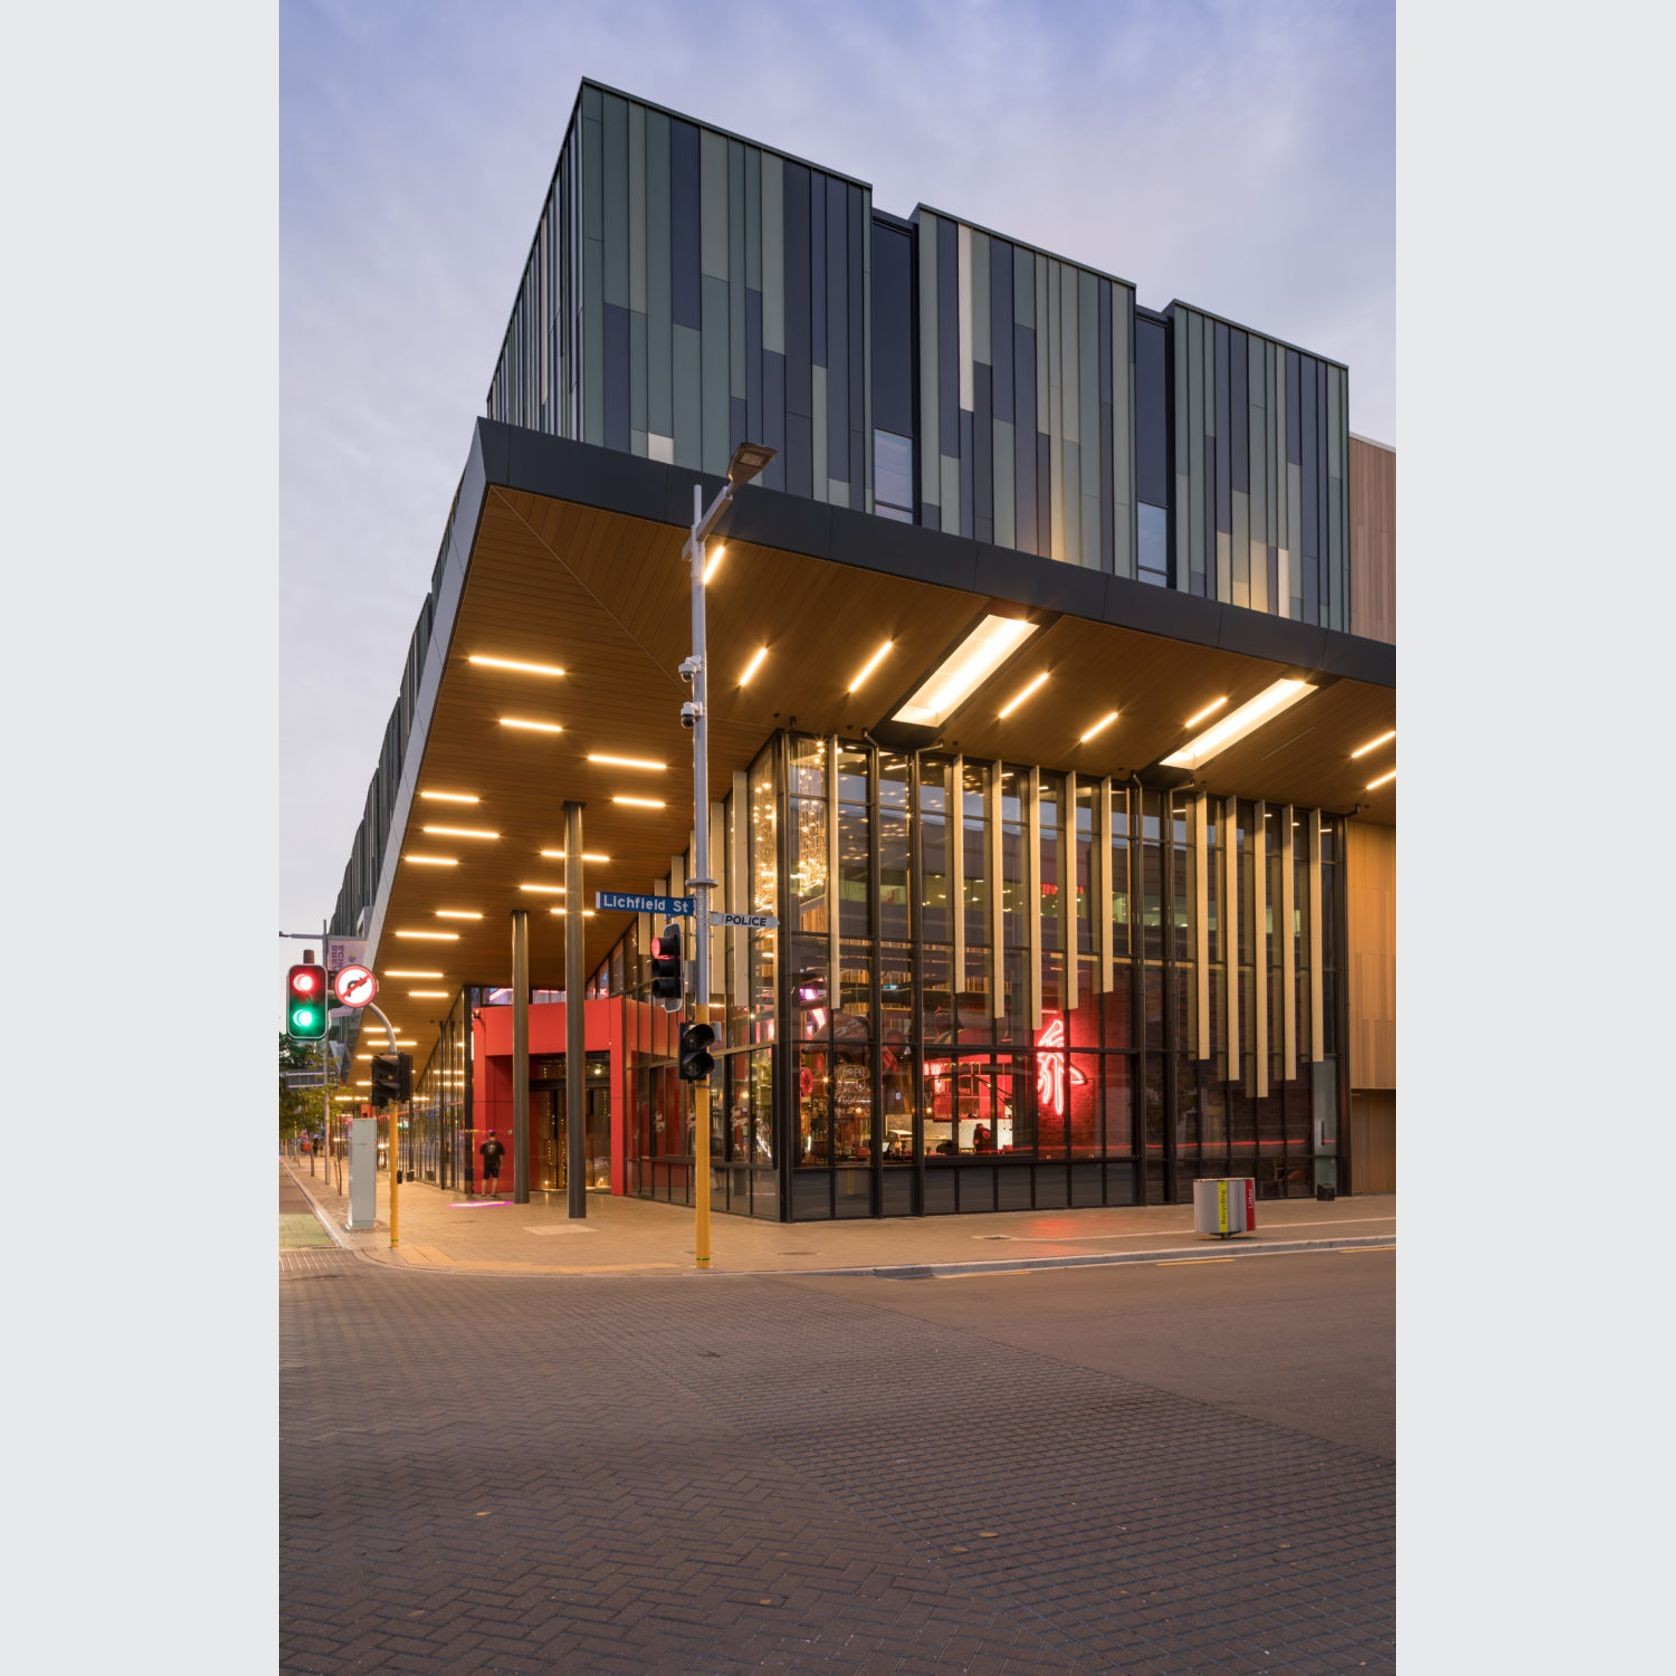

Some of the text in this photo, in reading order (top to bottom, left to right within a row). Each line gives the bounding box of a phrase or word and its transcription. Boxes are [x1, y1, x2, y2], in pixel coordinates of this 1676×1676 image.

[603, 894, 689, 913] Lichfield St
[725, 914, 767, 927] POLICE
